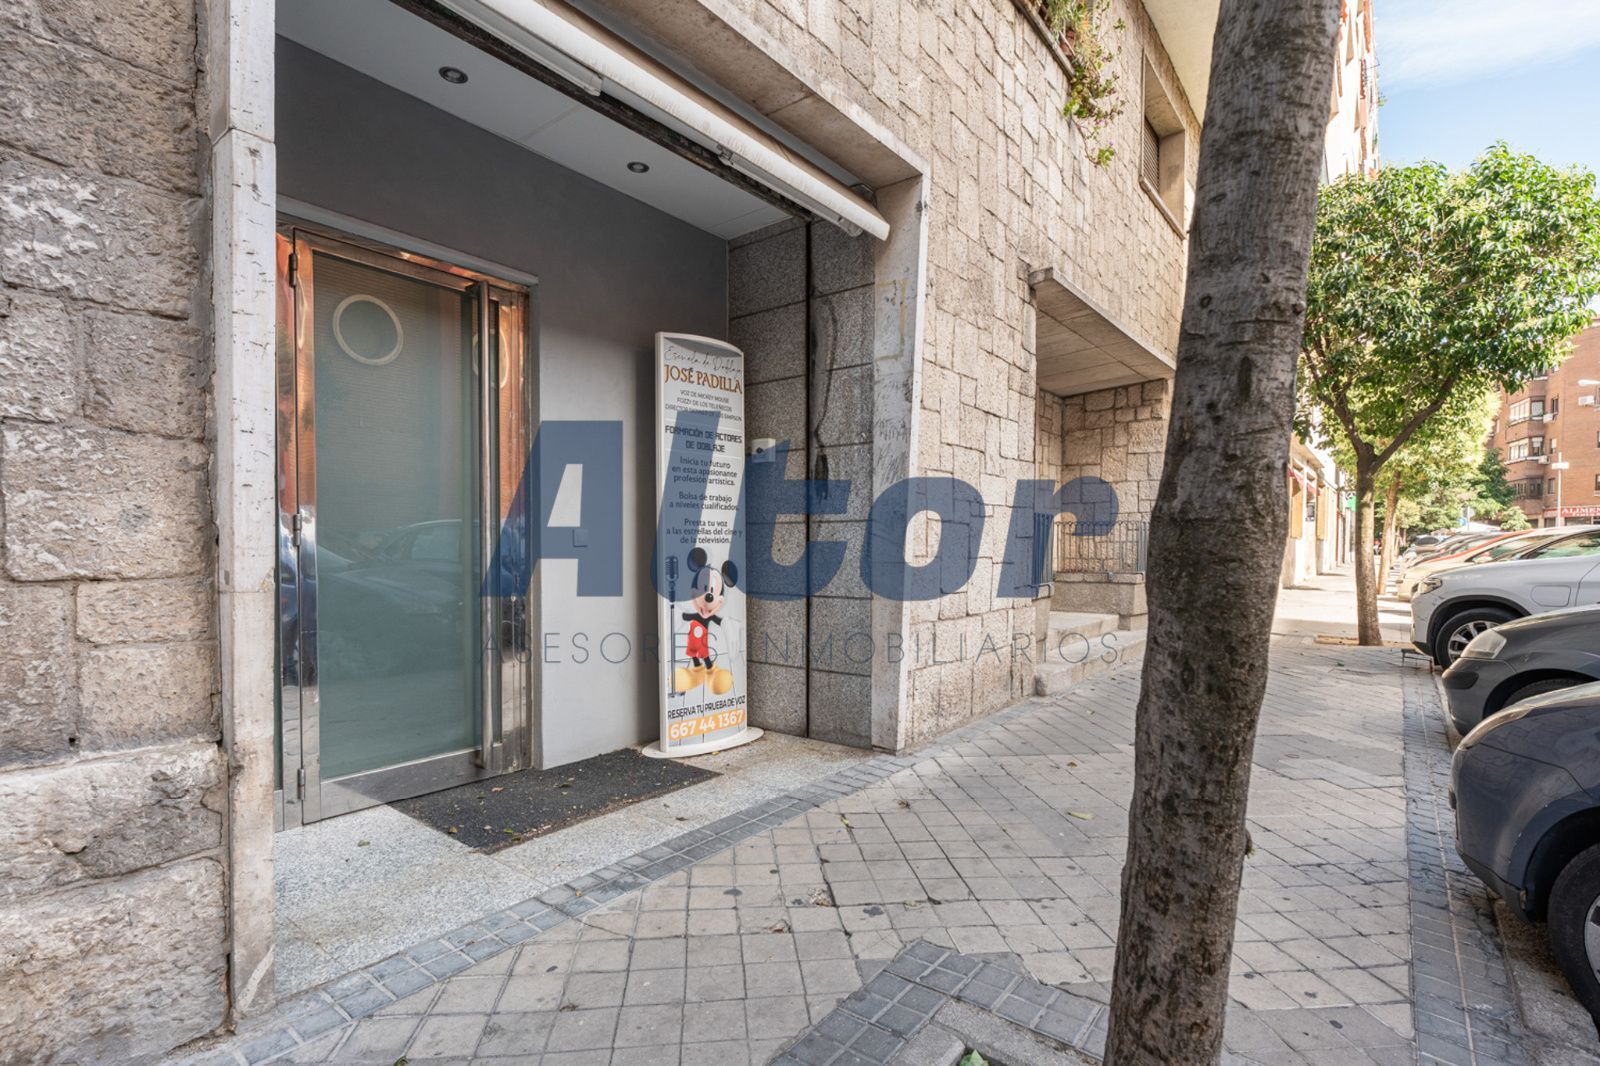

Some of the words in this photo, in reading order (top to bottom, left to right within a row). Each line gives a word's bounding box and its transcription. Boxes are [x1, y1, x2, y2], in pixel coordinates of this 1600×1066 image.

[664, 364, 694, 384] JOSÉ
[696, 370, 742, 394] PADILLA
[698, 392, 713, 400] MICKEY
[665, 425, 703, 437] FORMACIÓN
[705, 431, 713, 439] DE
[714, 432, 742, 443] ACTORES
[697, 442, 725, 452] DOBLAJE
[680, 456, 699, 465] Inicia
[709, 460, 731, 469] futuro
[674, 475, 707, 483] profesión
[699, 468, 737, 478] apasionante
[679, 491, 697, 500] Bolsa
[709, 495, 732, 503] trabajo
[684, 518, 706, 527] Presta
[668, 706, 696, 720] RESERVA
[697, 705, 703, 714] TU
[705, 700, 726, 712] PRUEBA
[727, 698, 735, 707] DE
[736, 695, 745, 705] VOZ
[670, 720, 697, 738] 667
[699, 716, 715, 732] 44
[718, 709, 744, 728] 1367
